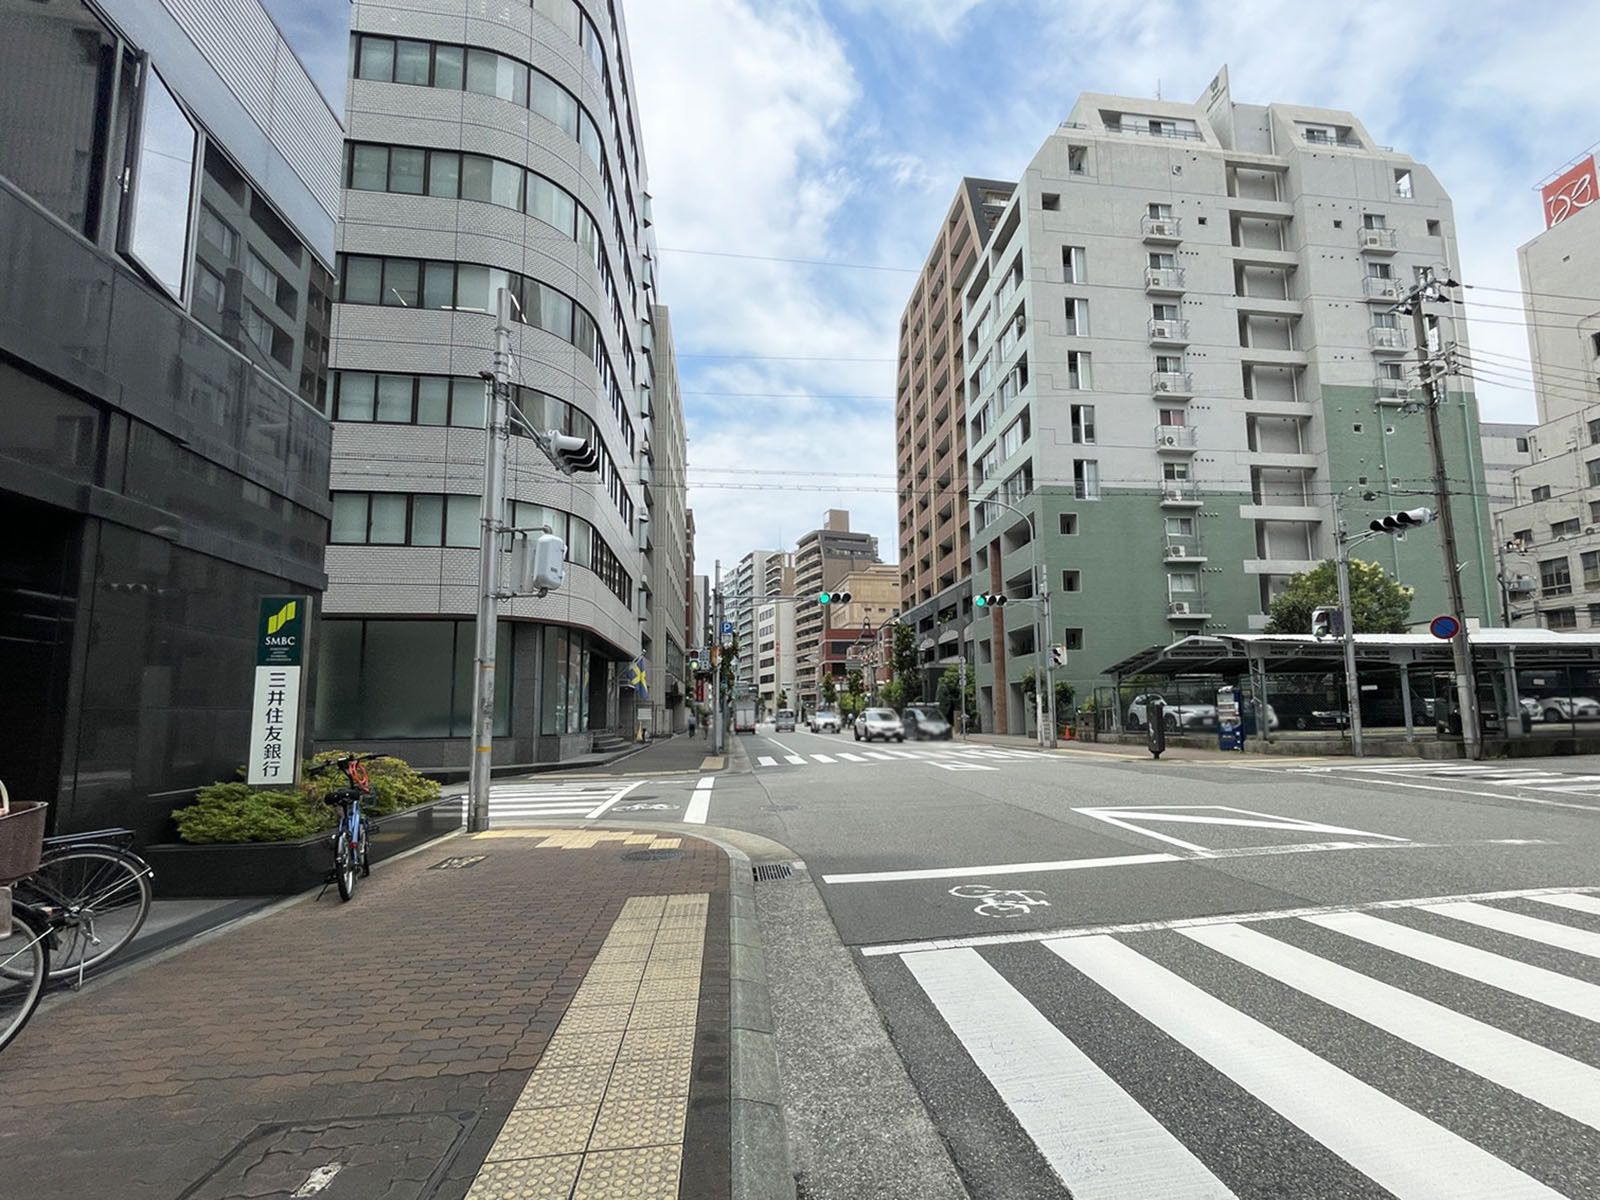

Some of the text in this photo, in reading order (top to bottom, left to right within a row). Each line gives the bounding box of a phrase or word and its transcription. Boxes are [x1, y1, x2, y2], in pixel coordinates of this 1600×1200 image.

[265, 636, 296, 646] SMBC
[262, 672, 286, 777] 三井住友銀行
